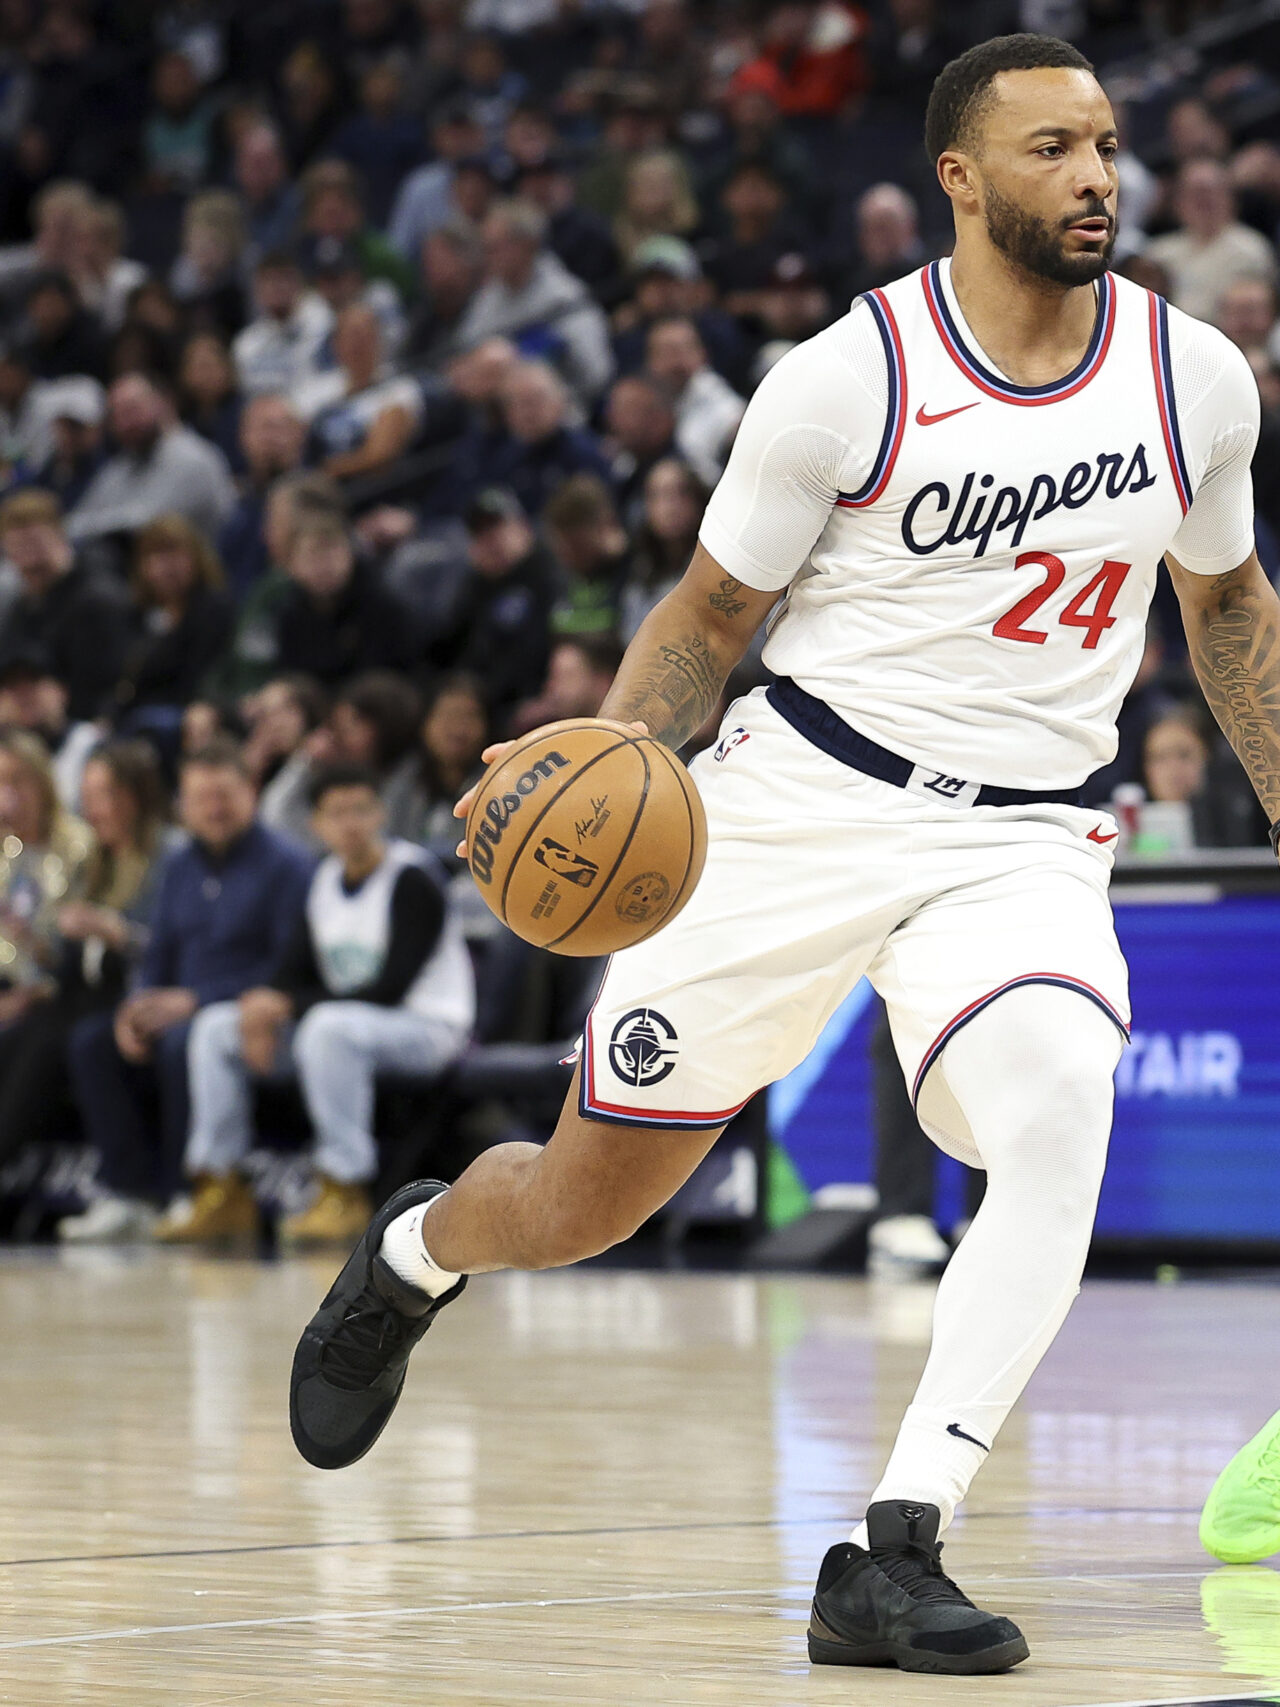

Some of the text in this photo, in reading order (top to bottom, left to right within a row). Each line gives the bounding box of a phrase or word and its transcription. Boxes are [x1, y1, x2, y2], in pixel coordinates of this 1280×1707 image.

[901, 443, 1157, 558] Clippers
[992, 551, 1132, 649] 24
[472, 751, 572, 885] Wilson
